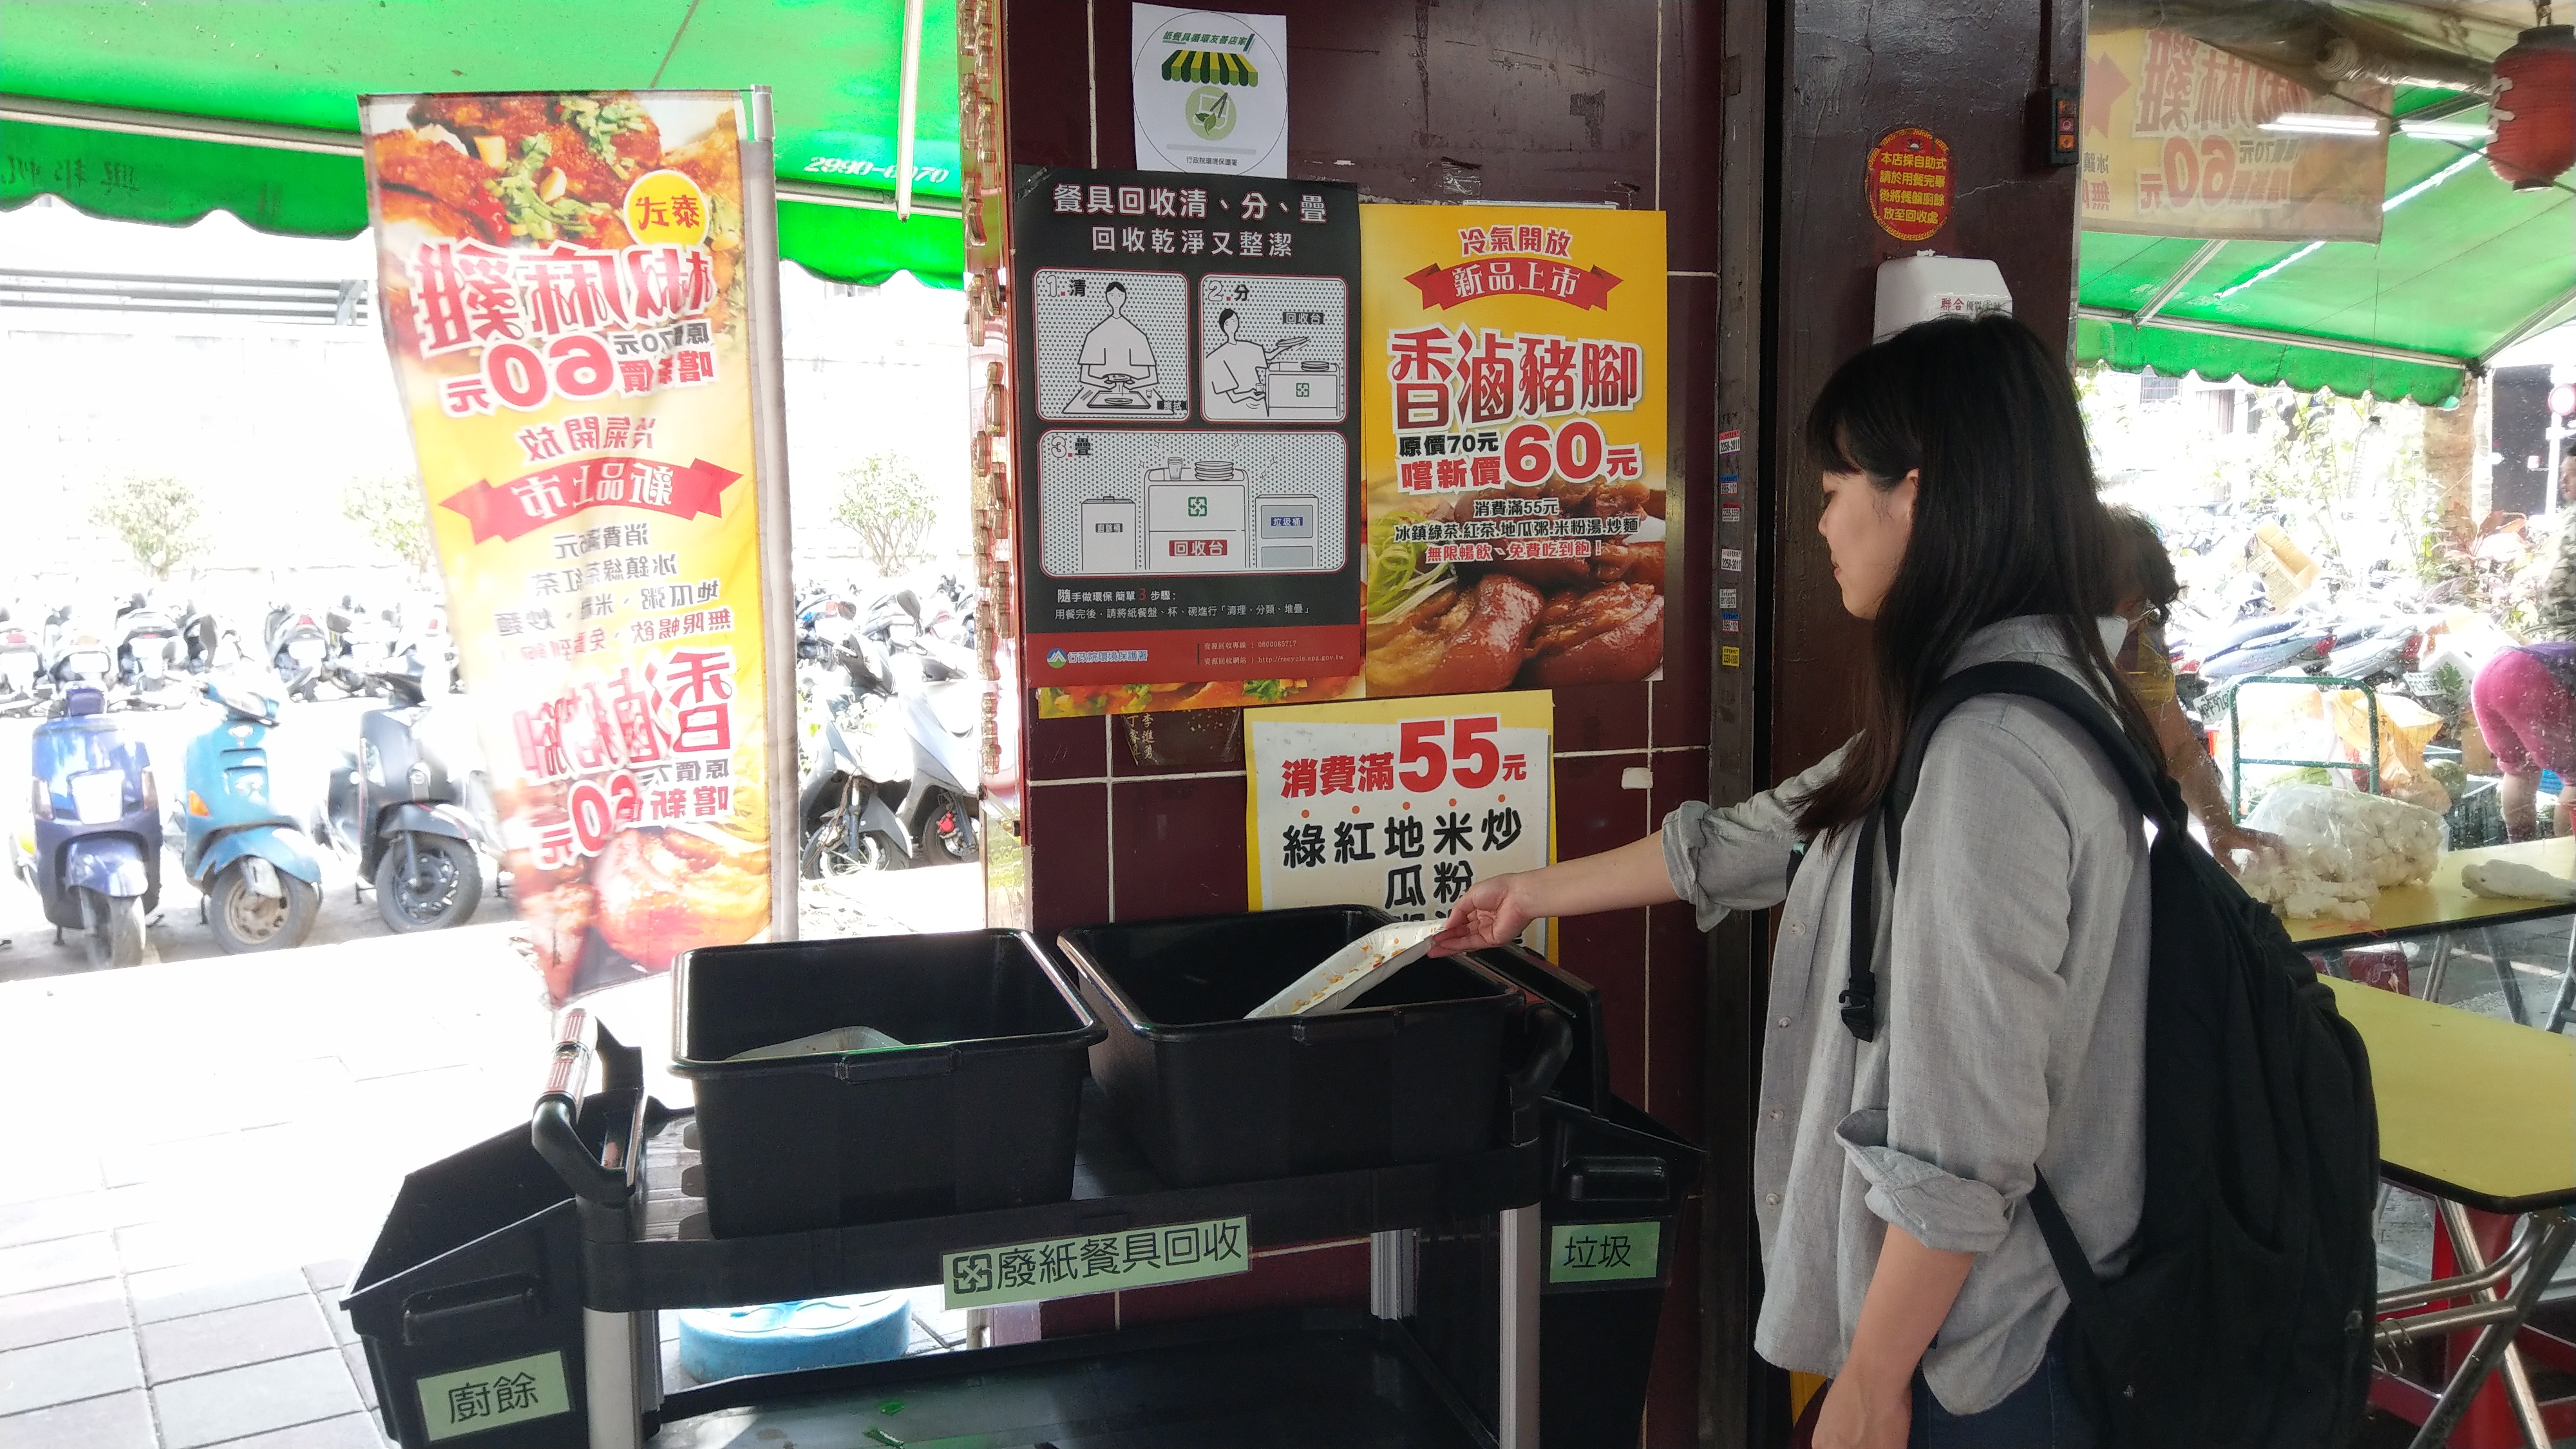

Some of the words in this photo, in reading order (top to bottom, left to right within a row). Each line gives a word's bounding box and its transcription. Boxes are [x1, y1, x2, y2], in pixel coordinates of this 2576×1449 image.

[1880, 152, 1947, 170] 本店採自助式
[1880, 170, 1946, 188] 請於用餐完畢
[1053, 183, 1327, 223] 餐具回收清、分、疊
[1092, 225, 1293, 258] 回收乾淨又整潔
[1461, 226, 1571, 257] 冷氣開放
[1453, 261, 1582, 298] 新品上市
[1286, 312, 1321, 325] 回收台
[1391, 327, 1638, 430] 香滷豬腳
[1399, 431, 1499, 457] 原價70元
[1273, 517, 1301, 527] 垃圾桶
[1475, 499, 1559, 518] 消費滿55元
[1174, 540, 1224, 556] 回收台
[1115, 591, 1136, 602] 簡單
[1139, 587, 1147, 601] 3
[1067, 650, 1148, 664] 行政院環境保護署
[2197, 693, 2229, 720] MPF-926
[1280, 715, 1528, 799] 消費滿55元
[997, 1222, 1243, 1290] 廢紙餐具回收
[1563, 1235, 1631, 1268] 垃圾
[448, 1370, 539, 1425] 廚餘
